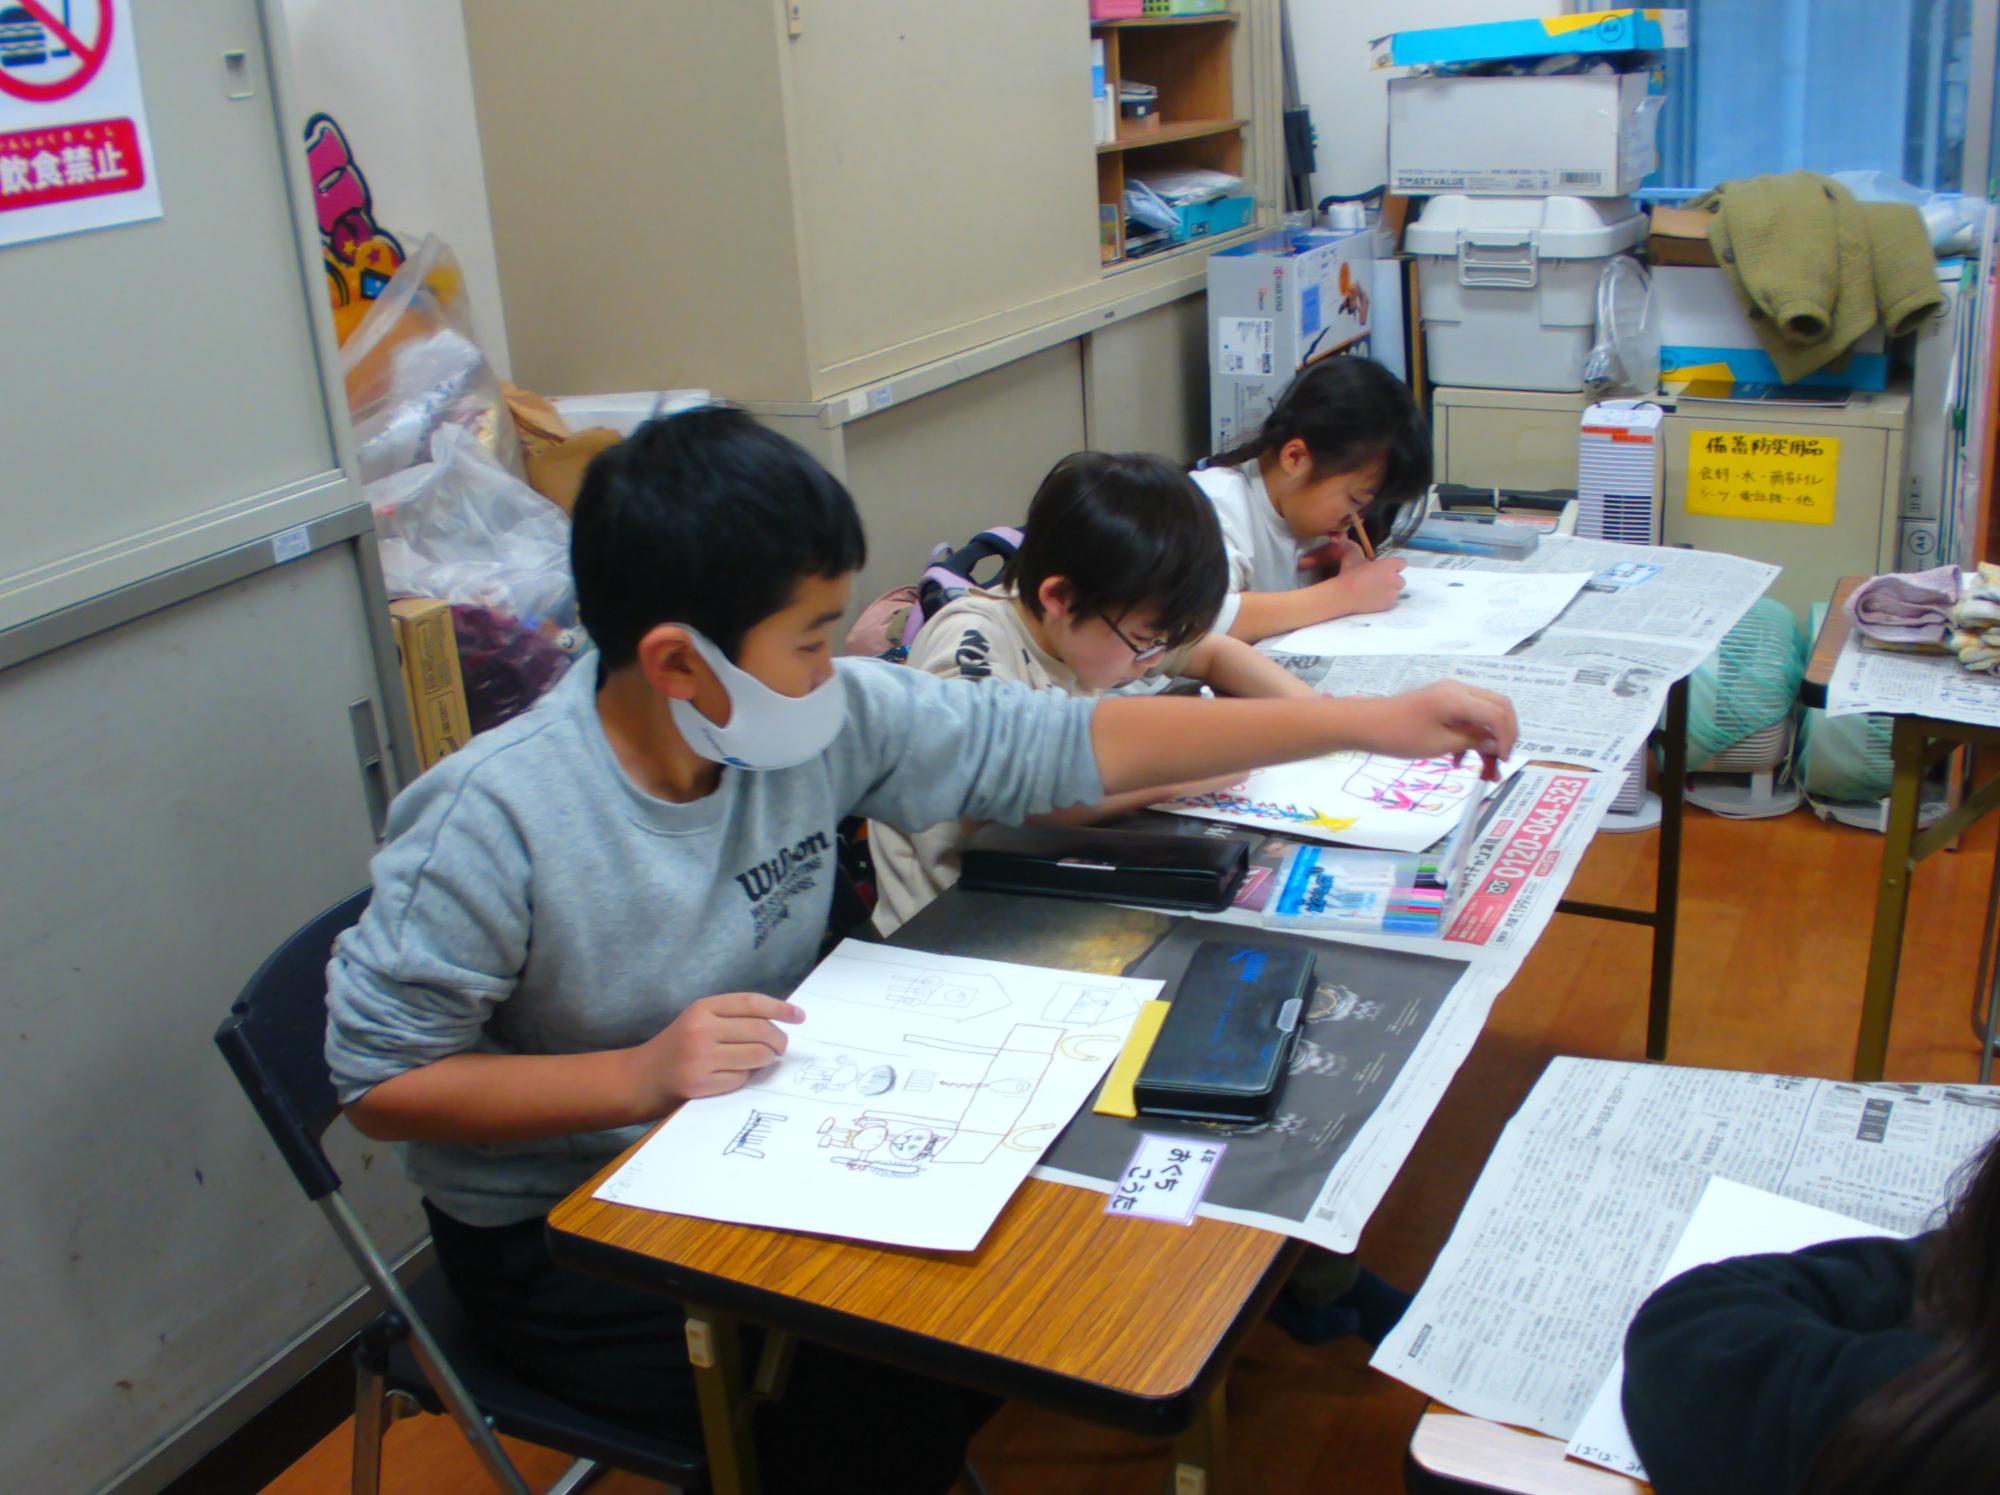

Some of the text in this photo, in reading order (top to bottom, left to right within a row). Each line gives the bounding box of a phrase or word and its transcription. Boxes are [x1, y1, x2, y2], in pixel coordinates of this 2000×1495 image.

[1, 141, 128, 191] 飲食禁止
[1493, 778, 1584, 879] 0120-064-523
[736, 831, 830, 901] Wilson
[1112, 1166, 1152, 1211] こうた
[1154, 1148, 1191, 1192] おぐち
